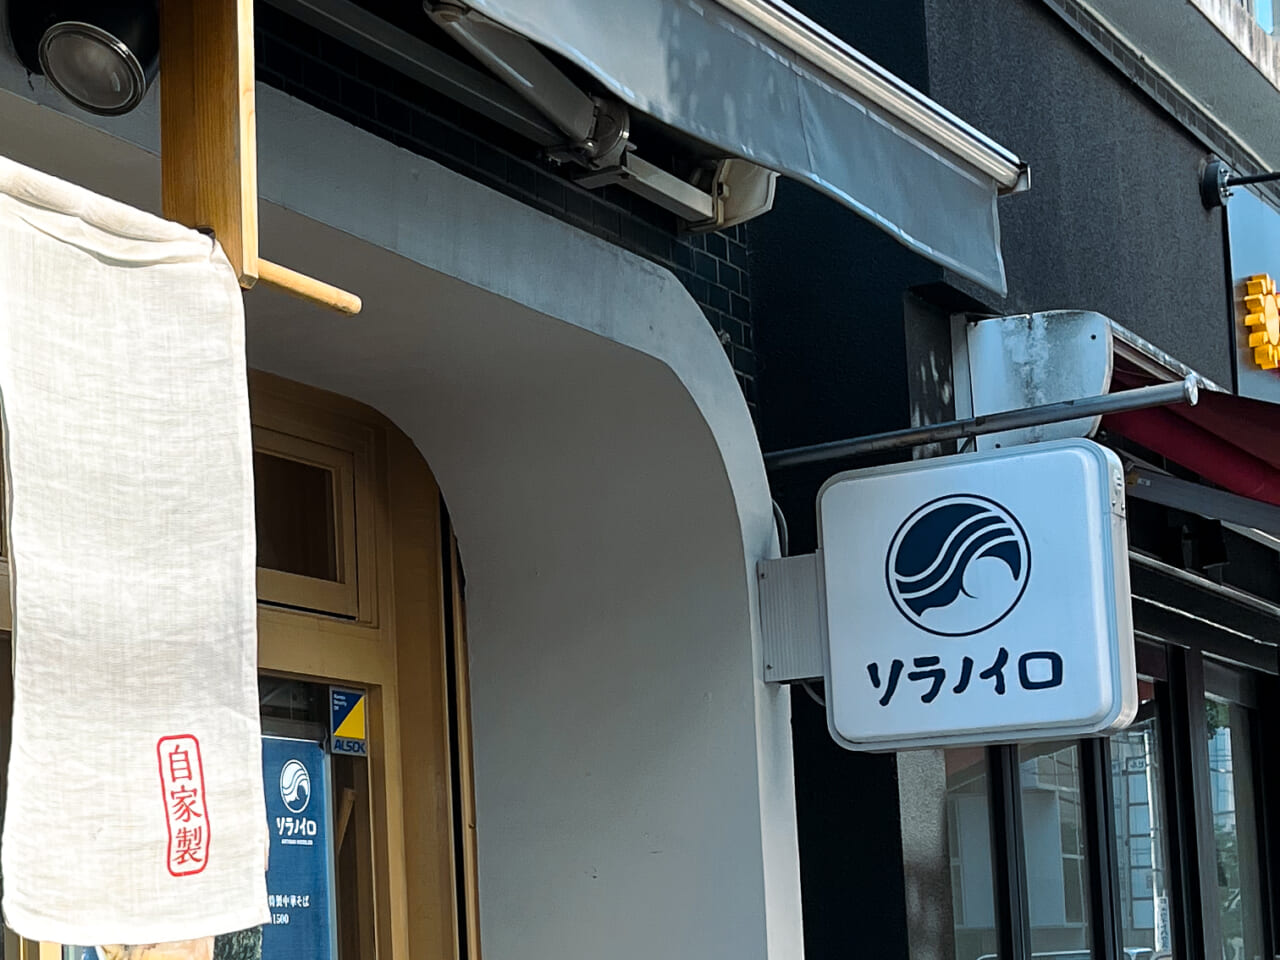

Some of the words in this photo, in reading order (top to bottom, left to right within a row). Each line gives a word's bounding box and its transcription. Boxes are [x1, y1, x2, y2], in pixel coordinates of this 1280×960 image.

[867, 647, 1063, 707] ソラノイロ
[334, 739, 366, 754] ALSOK
[167, 744, 203, 866] 自家製
[276, 817, 317, 836] ソラノイロ
